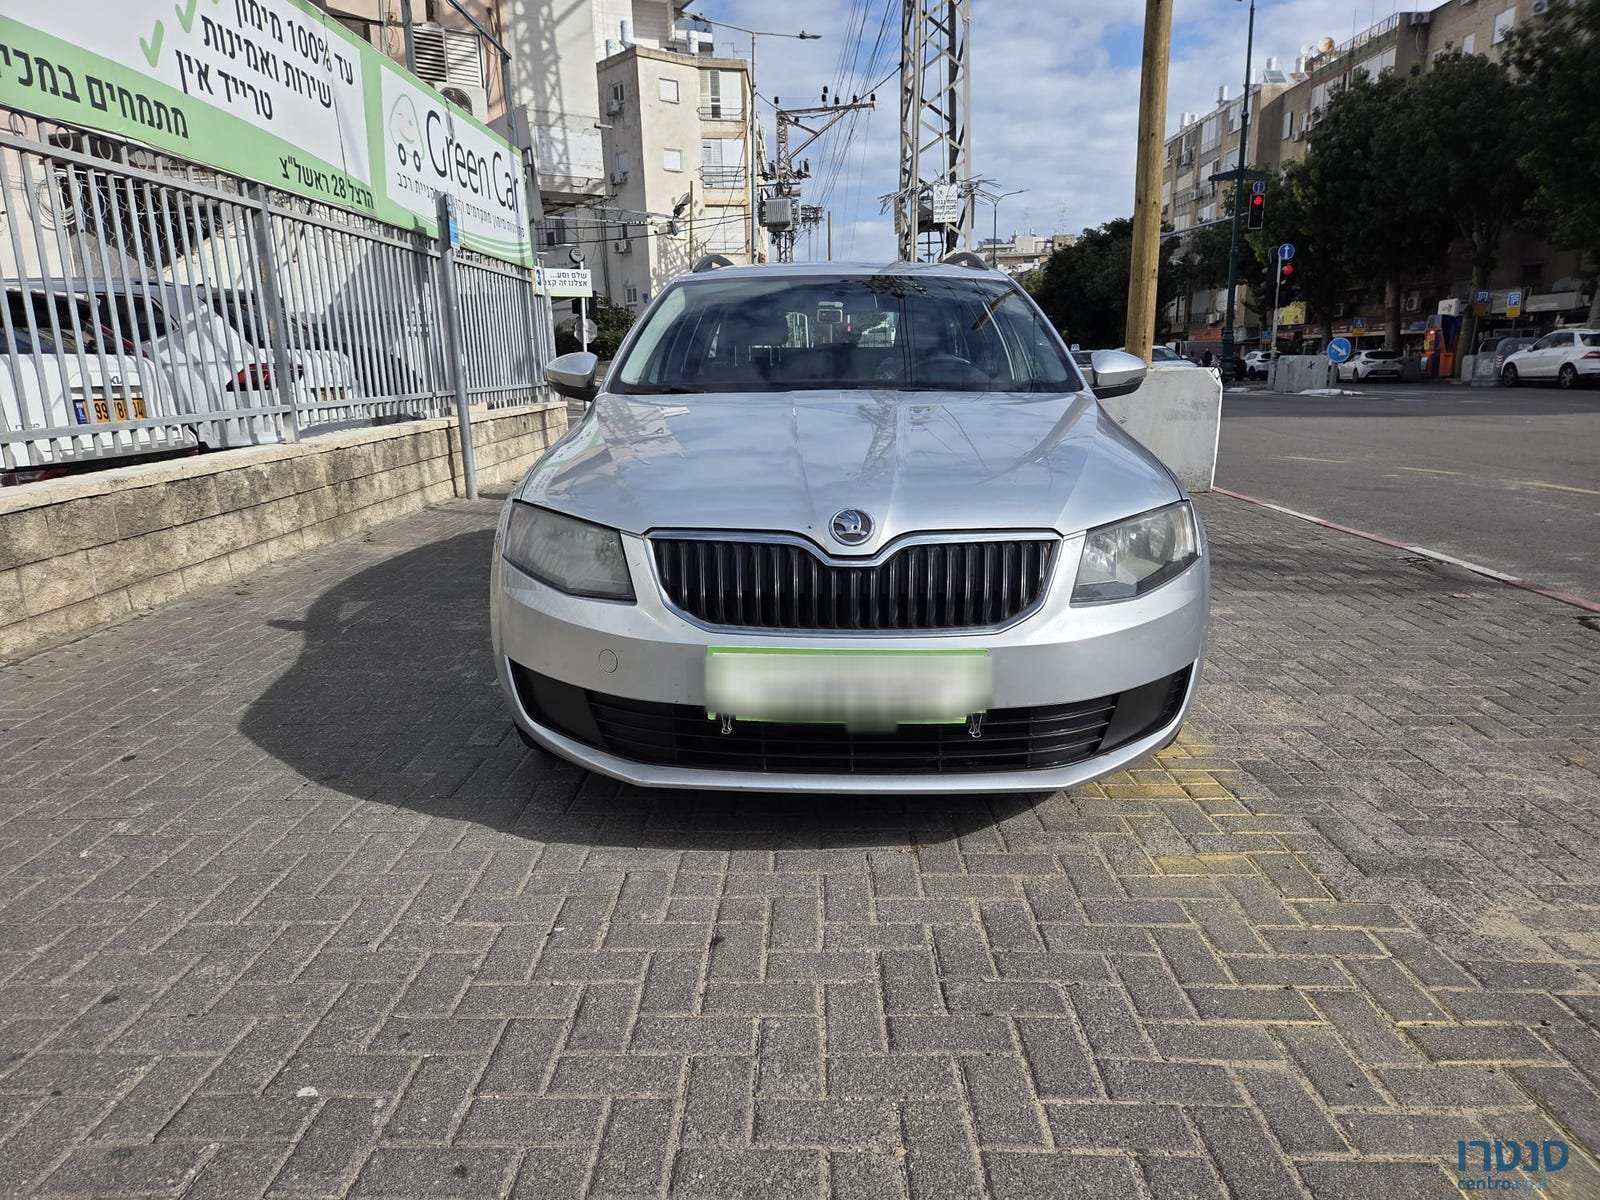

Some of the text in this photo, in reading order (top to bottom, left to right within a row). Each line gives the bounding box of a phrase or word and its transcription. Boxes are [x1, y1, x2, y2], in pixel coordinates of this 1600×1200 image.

[201, 14, 332, 108] שירות ואמינות
[235, 0, 353, 85] עד 100% מימון
[0, 43, 189, 139] מתמחים במכי
[175, 49, 273, 120] טרייד אין
[331, 174, 347, 199] 28
[348, 179, 375, 209] הרצל
[426, 109, 519, 213] Green Car
[568, 279, 588, 287] אצלנו
[571, 271, 587, 279] שלם
